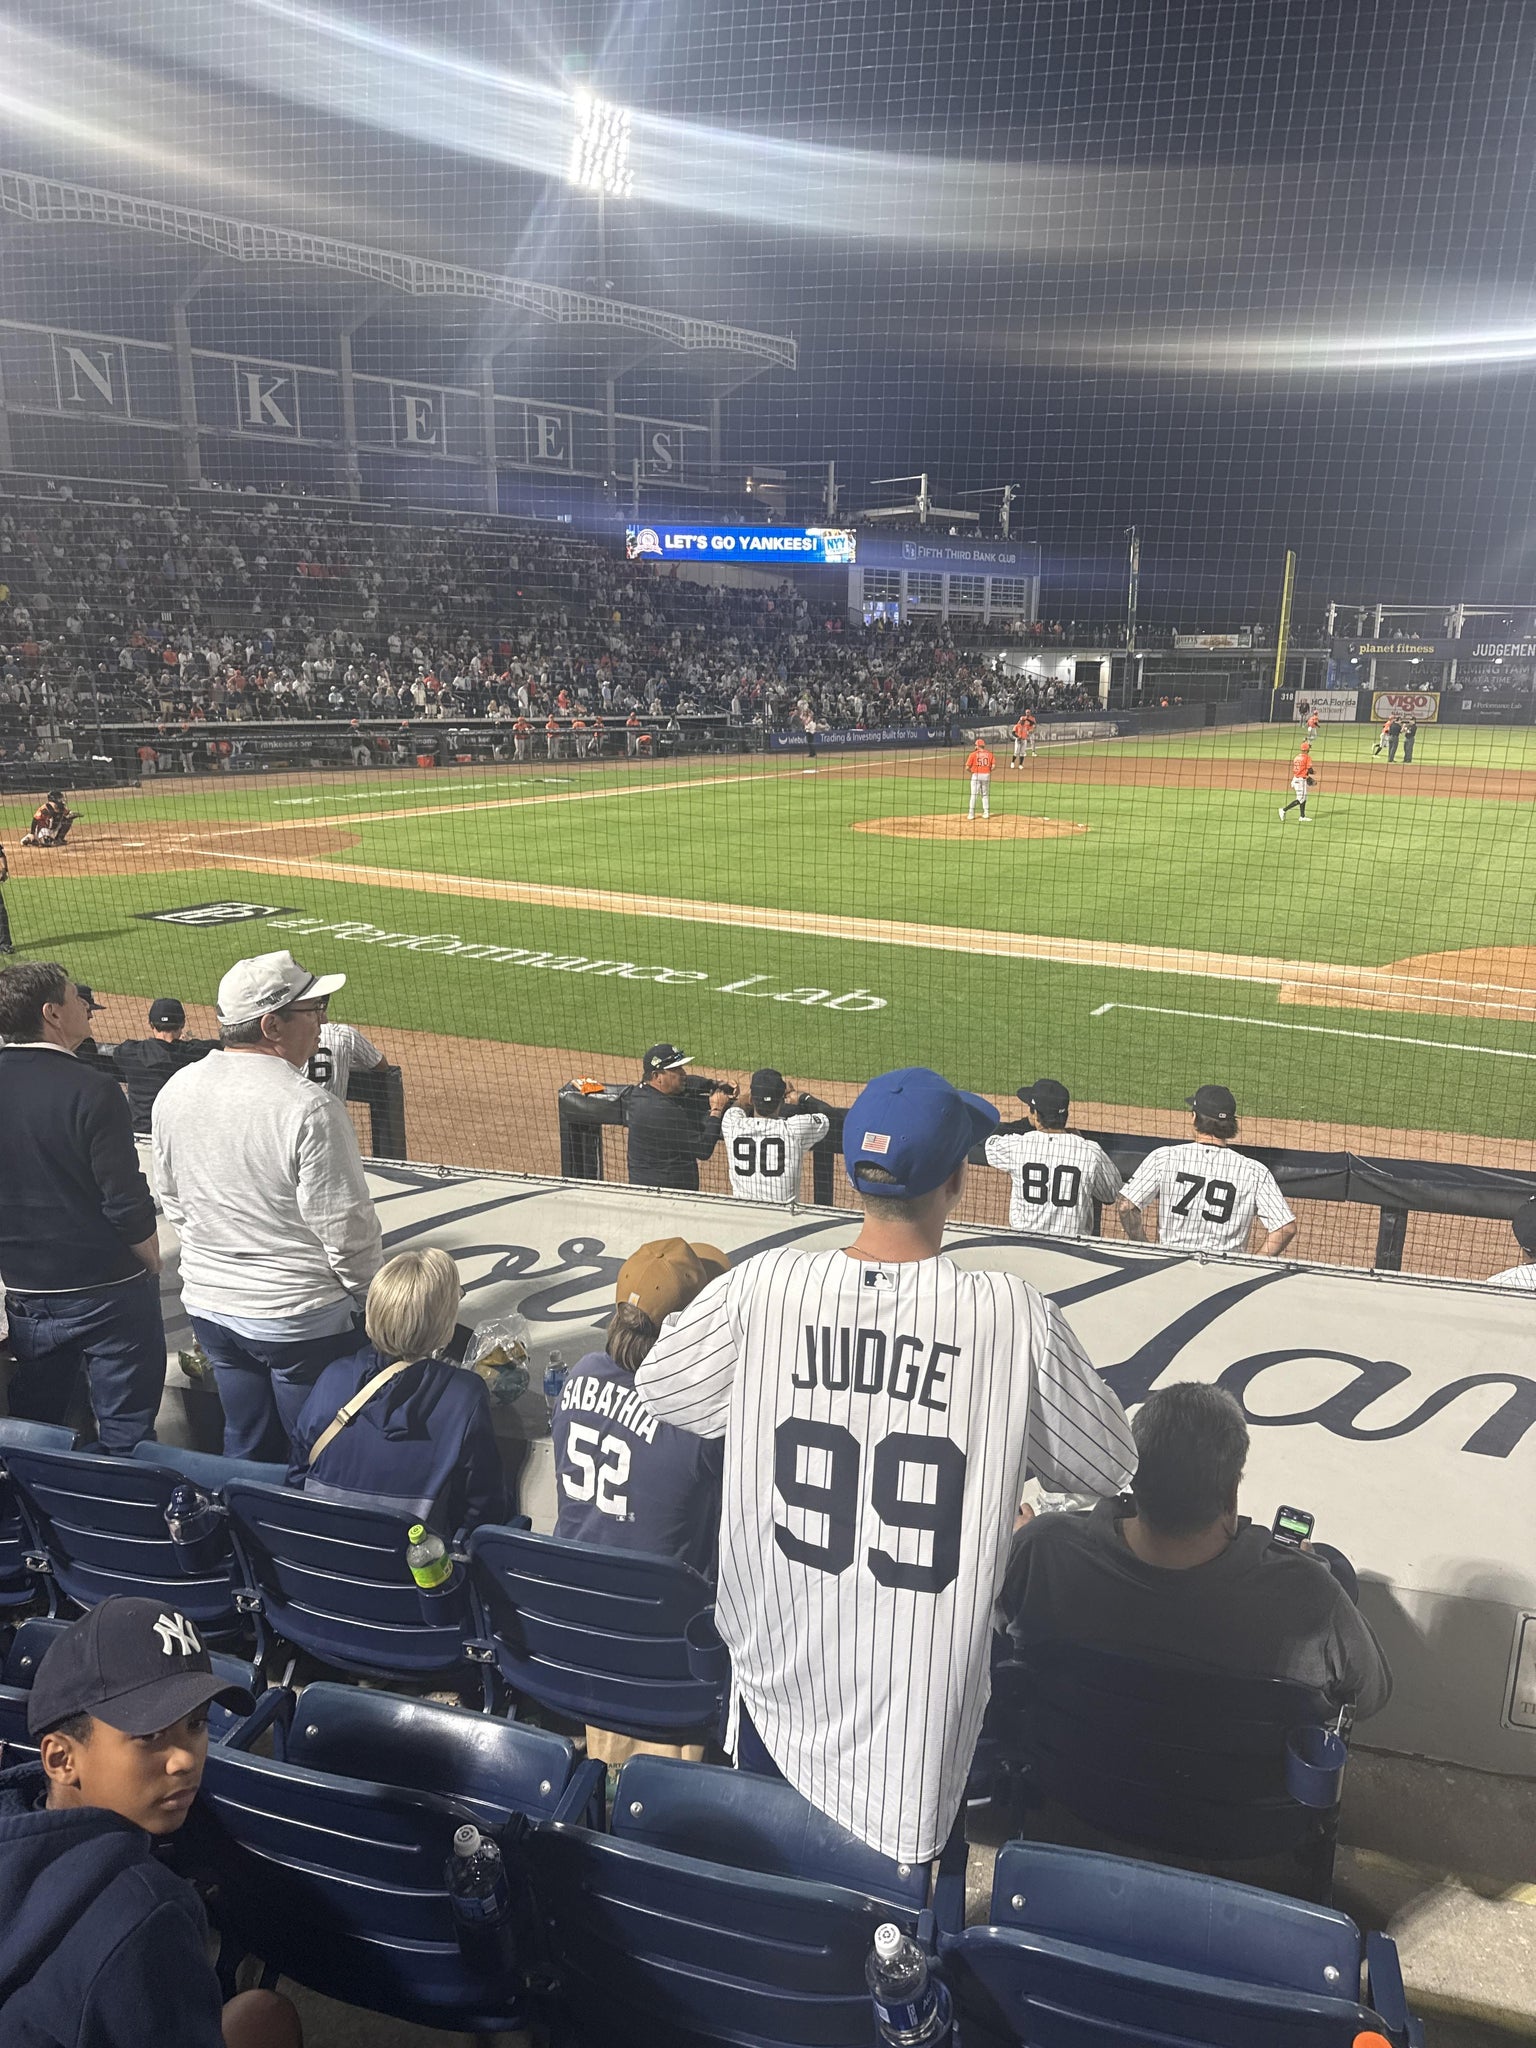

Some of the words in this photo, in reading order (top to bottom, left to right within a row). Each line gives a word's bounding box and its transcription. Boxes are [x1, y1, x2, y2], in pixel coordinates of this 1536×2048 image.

[664, 534, 708, 550] LET'S
[710, 535, 736, 551] GO
[738, 535, 818, 552] YANKEES!
[826, 537, 846, 550] NYY
[918, 545, 943, 559] FIFTH
[945, 548, 971, 560] THIRD
[973, 550, 996, 562] BANK
[998, 552, 1016, 564] CLUB
[1359, 643, 1394, 655] planet
[1396, 642, 1436, 654] fitness
[1472, 643, 1536, 657] JUDGEMEN
[1280, 692, 1294, 701] 318
[1311, 698, 1328, 706] HCA
[1330, 698, 1357, 707] Florida
[820, 732, 845, 744] Trading
[845, 732, 851, 742] &
[852, 730, 882, 743] Investing
[882, 730, 896, 740] Built
[896, 729, 906, 739] for
[906, 729, 918, 739] You
[976, 757, 989, 767] 50
[288, 919, 709, 984] Performance
[704, 972, 888, 1012] Lab
[732, 1136, 785, 1178] 90
[1021, 1161, 1082, 1208] 80
[1171, 1171, 1237, 1225] 79
[791, 1324, 962, 1413] JUDGE
[560, 1375, 660, 1445] SABATHIA
[561, 1421, 632, 1516] 52
[773, 1415, 967, 1595] 99
[152, 1611, 202, 1657] NY
